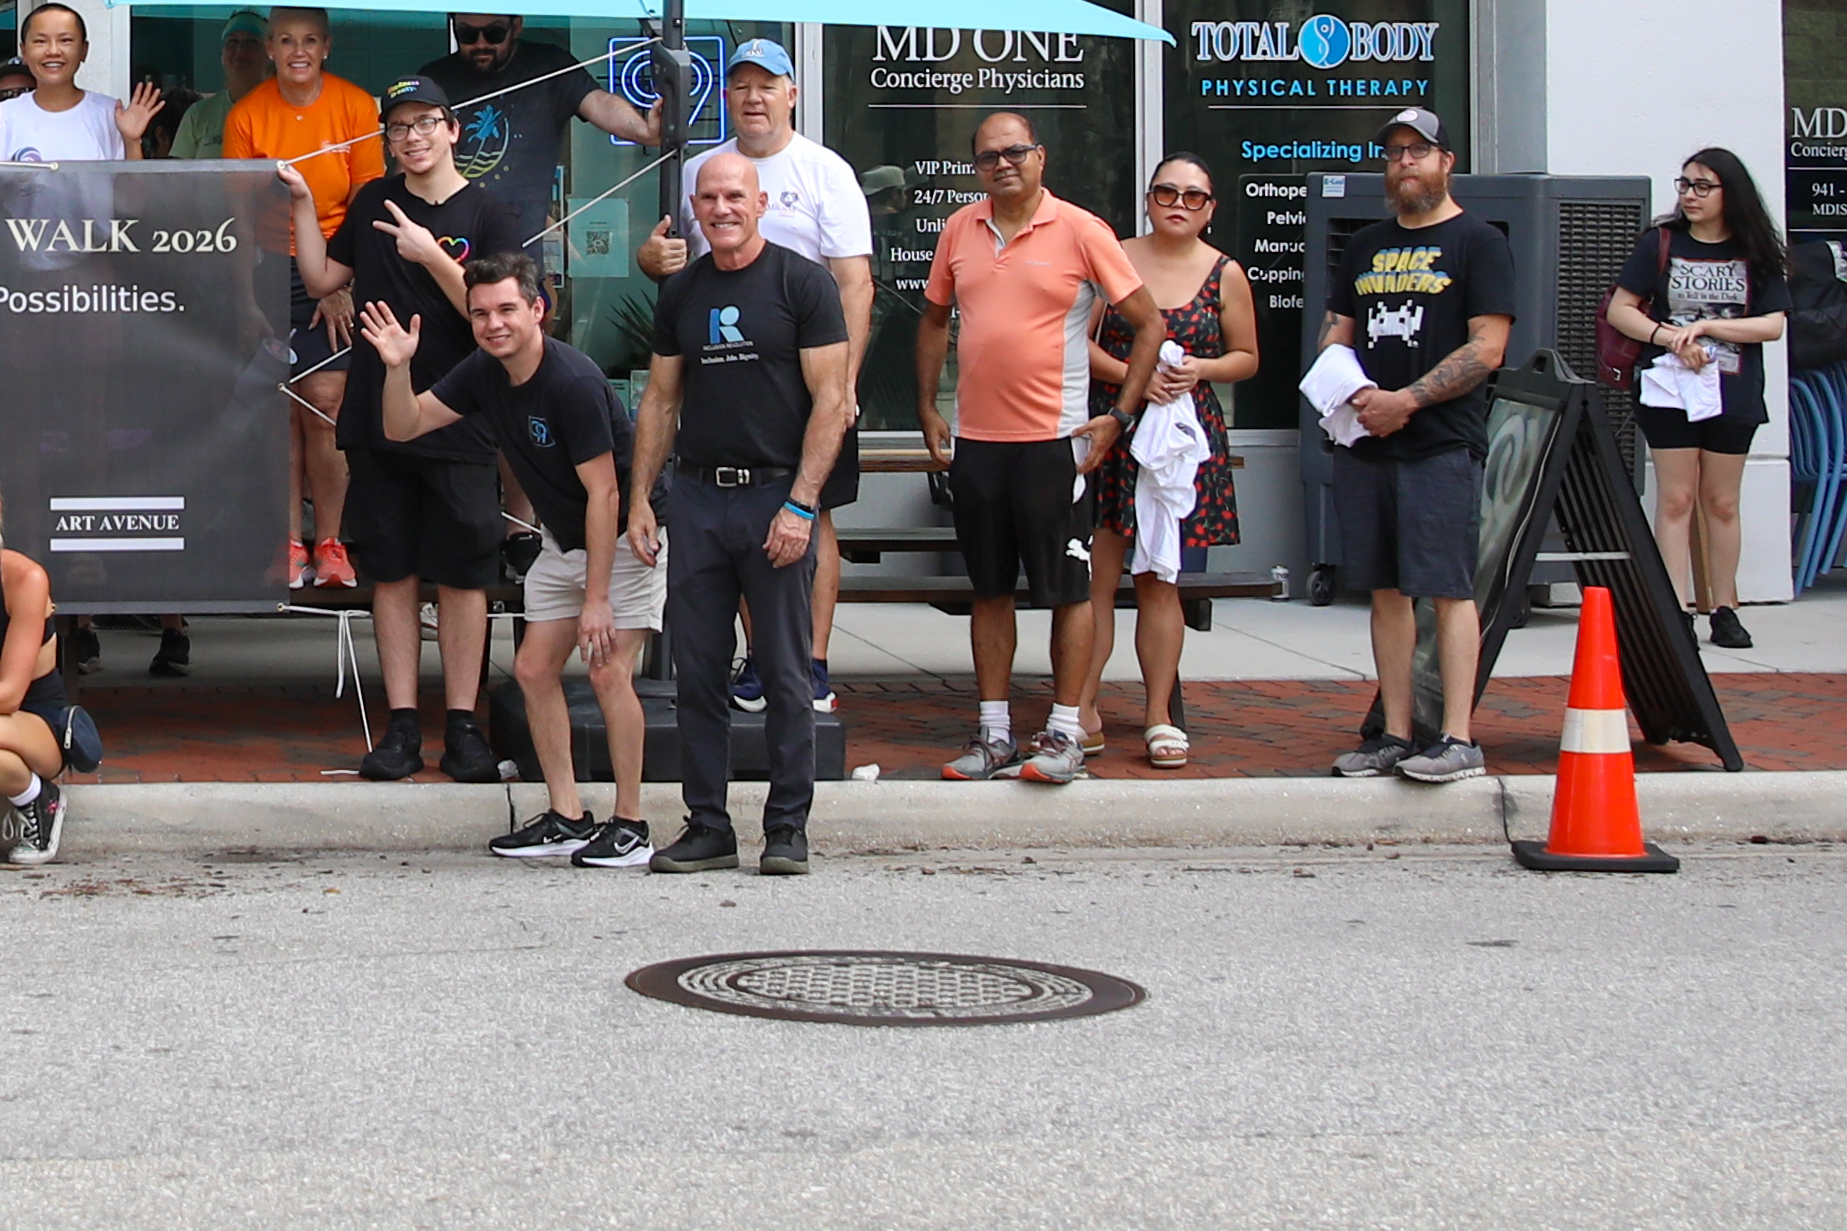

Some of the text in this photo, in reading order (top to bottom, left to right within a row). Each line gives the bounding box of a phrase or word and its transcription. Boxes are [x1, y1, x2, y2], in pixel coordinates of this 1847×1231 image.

[872, 25, 1084, 63] MD ONE
[1191, 21, 1440, 62] TOTAL BODY
[870, 67, 1085, 94] Concierge Physicians
[1201, 79, 1429, 96] PHYSICAL THERAPY
[1790, 107, 1847, 139] MD
[1241, 140, 1362, 163] Specializing
[914, 160, 940, 175] VIP
[914, 189, 945, 205] 24/7
[1811, 182, 1835, 197] 941
[5, 218, 141, 253] WALK
[152, 217, 238, 254] 2026
[890, 247, 934, 262] House
[1371, 245, 1443, 273] SPACE
[1247, 266, 1304, 284] Cuppin
[1680, 264, 1737, 277] SCARY
[1354, 270, 1454, 297] INVADERS
[1671, 277, 1746, 293] STORIES
[1686, 291, 1699, 300] Tell
[1709, 292, 1721, 301] the
[1722, 293, 1738, 301] Dark
[55, 514, 180, 532] ART AVENUE
